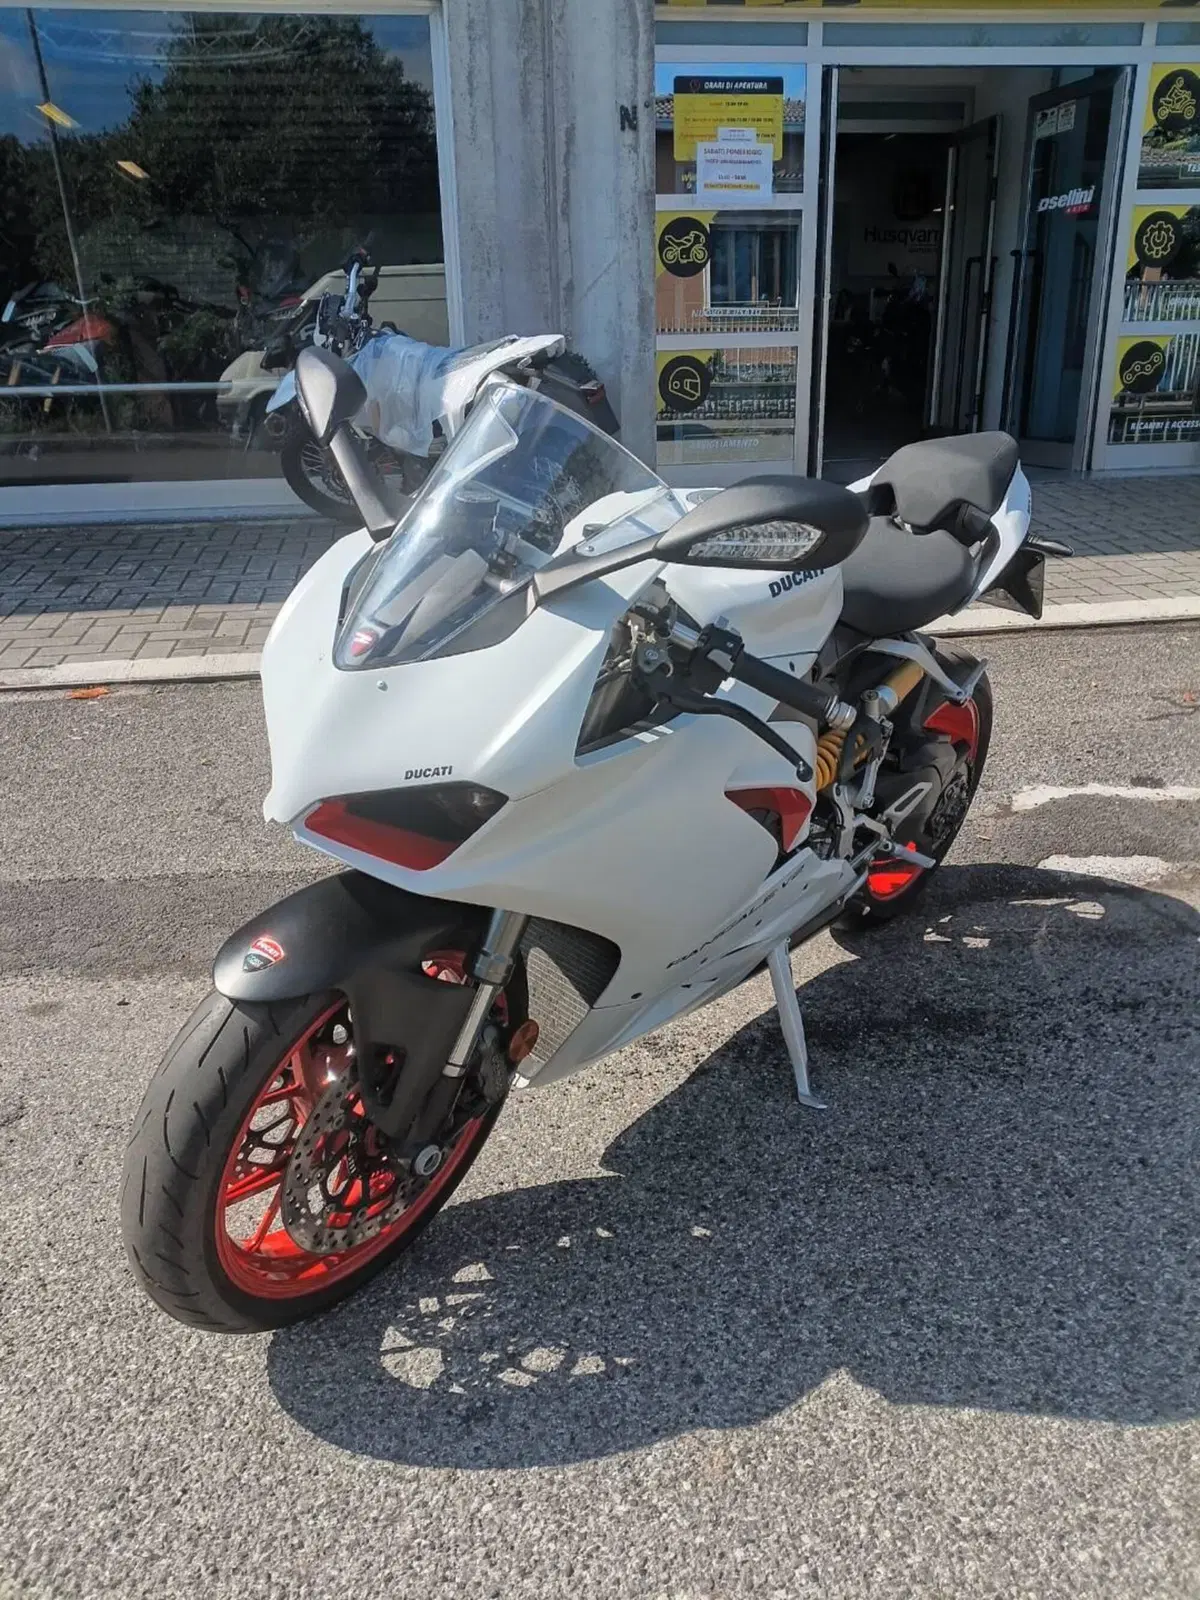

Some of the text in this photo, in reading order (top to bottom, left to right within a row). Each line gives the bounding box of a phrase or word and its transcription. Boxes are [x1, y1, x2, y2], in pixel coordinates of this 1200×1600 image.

[704, 81, 725, 90] ORARI
[734, 81, 768, 90] APERTURA
[864, 226, 943, 247] Husqvarn
[404, 765, 453, 780] DUCATI
